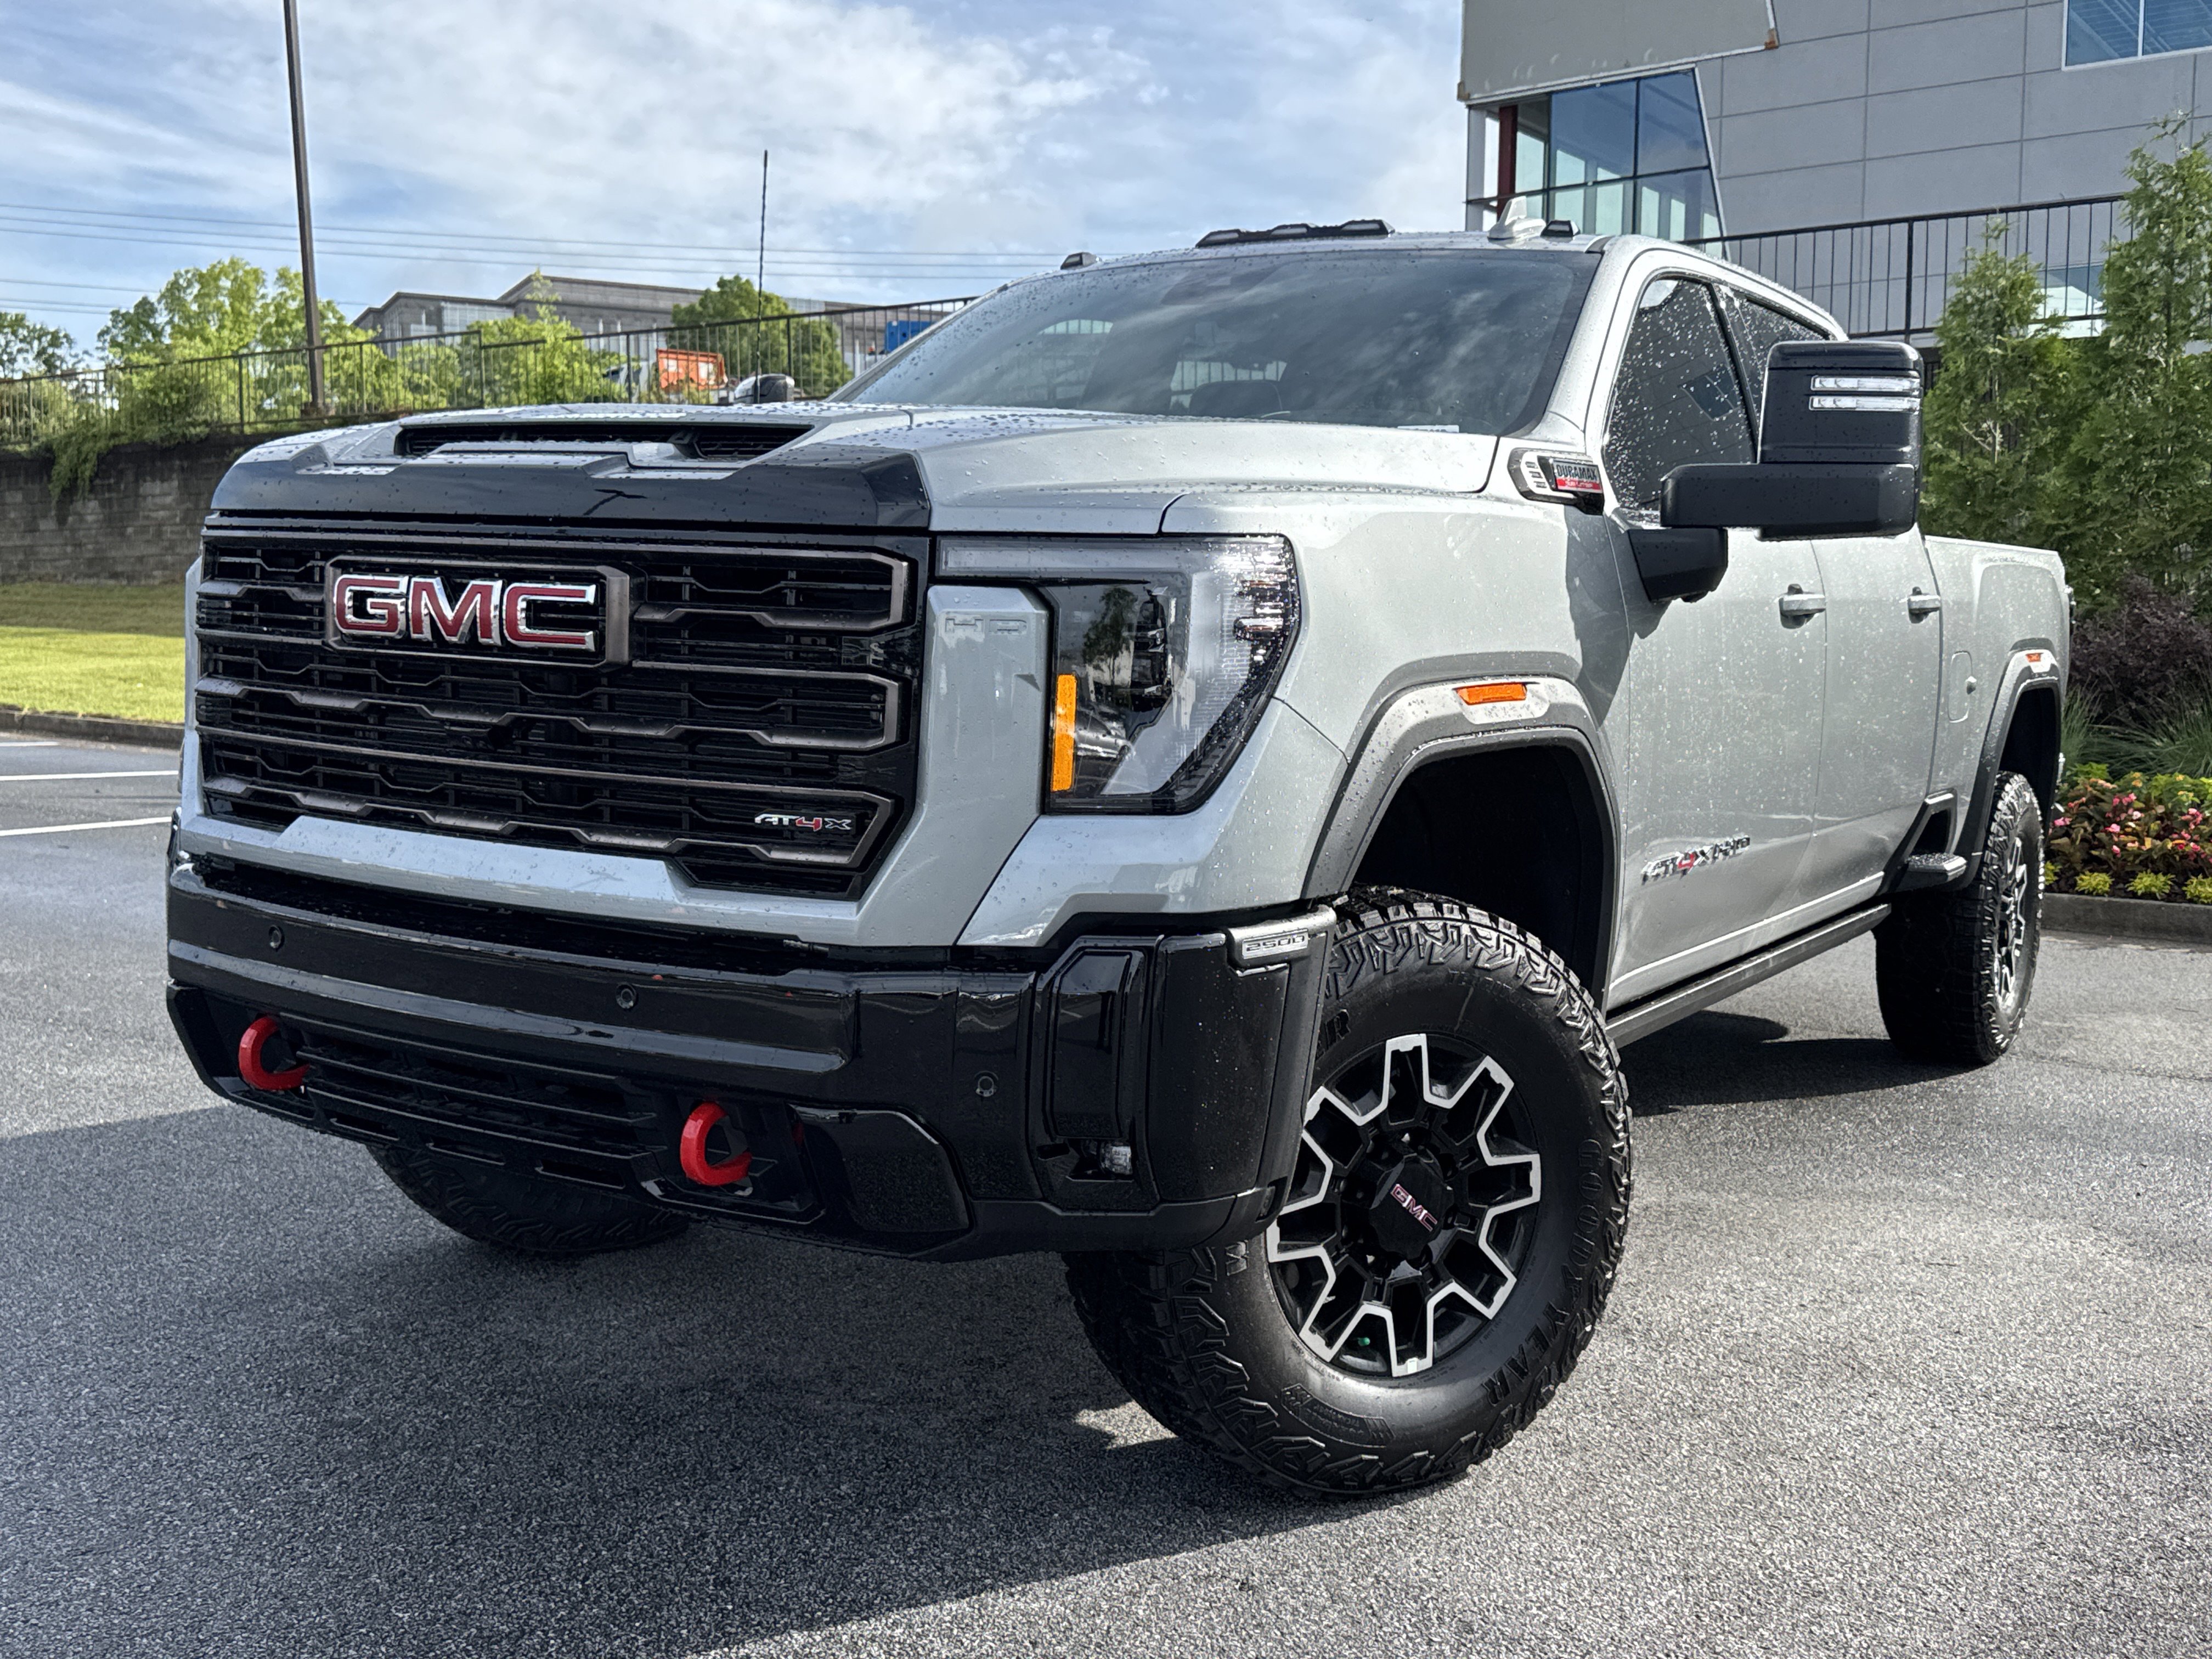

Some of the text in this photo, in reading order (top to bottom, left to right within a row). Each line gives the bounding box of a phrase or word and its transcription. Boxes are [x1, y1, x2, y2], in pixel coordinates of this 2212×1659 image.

[1556, 464, 1598, 481] DURAMAX
[334, 573, 596, 652] GMC
[945, 617, 1028, 634] HD
[754, 813, 851, 832] AT4X
[1246, 935, 1305, 952] 2500
[1390, 1183, 1438, 1232] GMC
[1482, 1138, 1605, 1408] GOODYEAR
